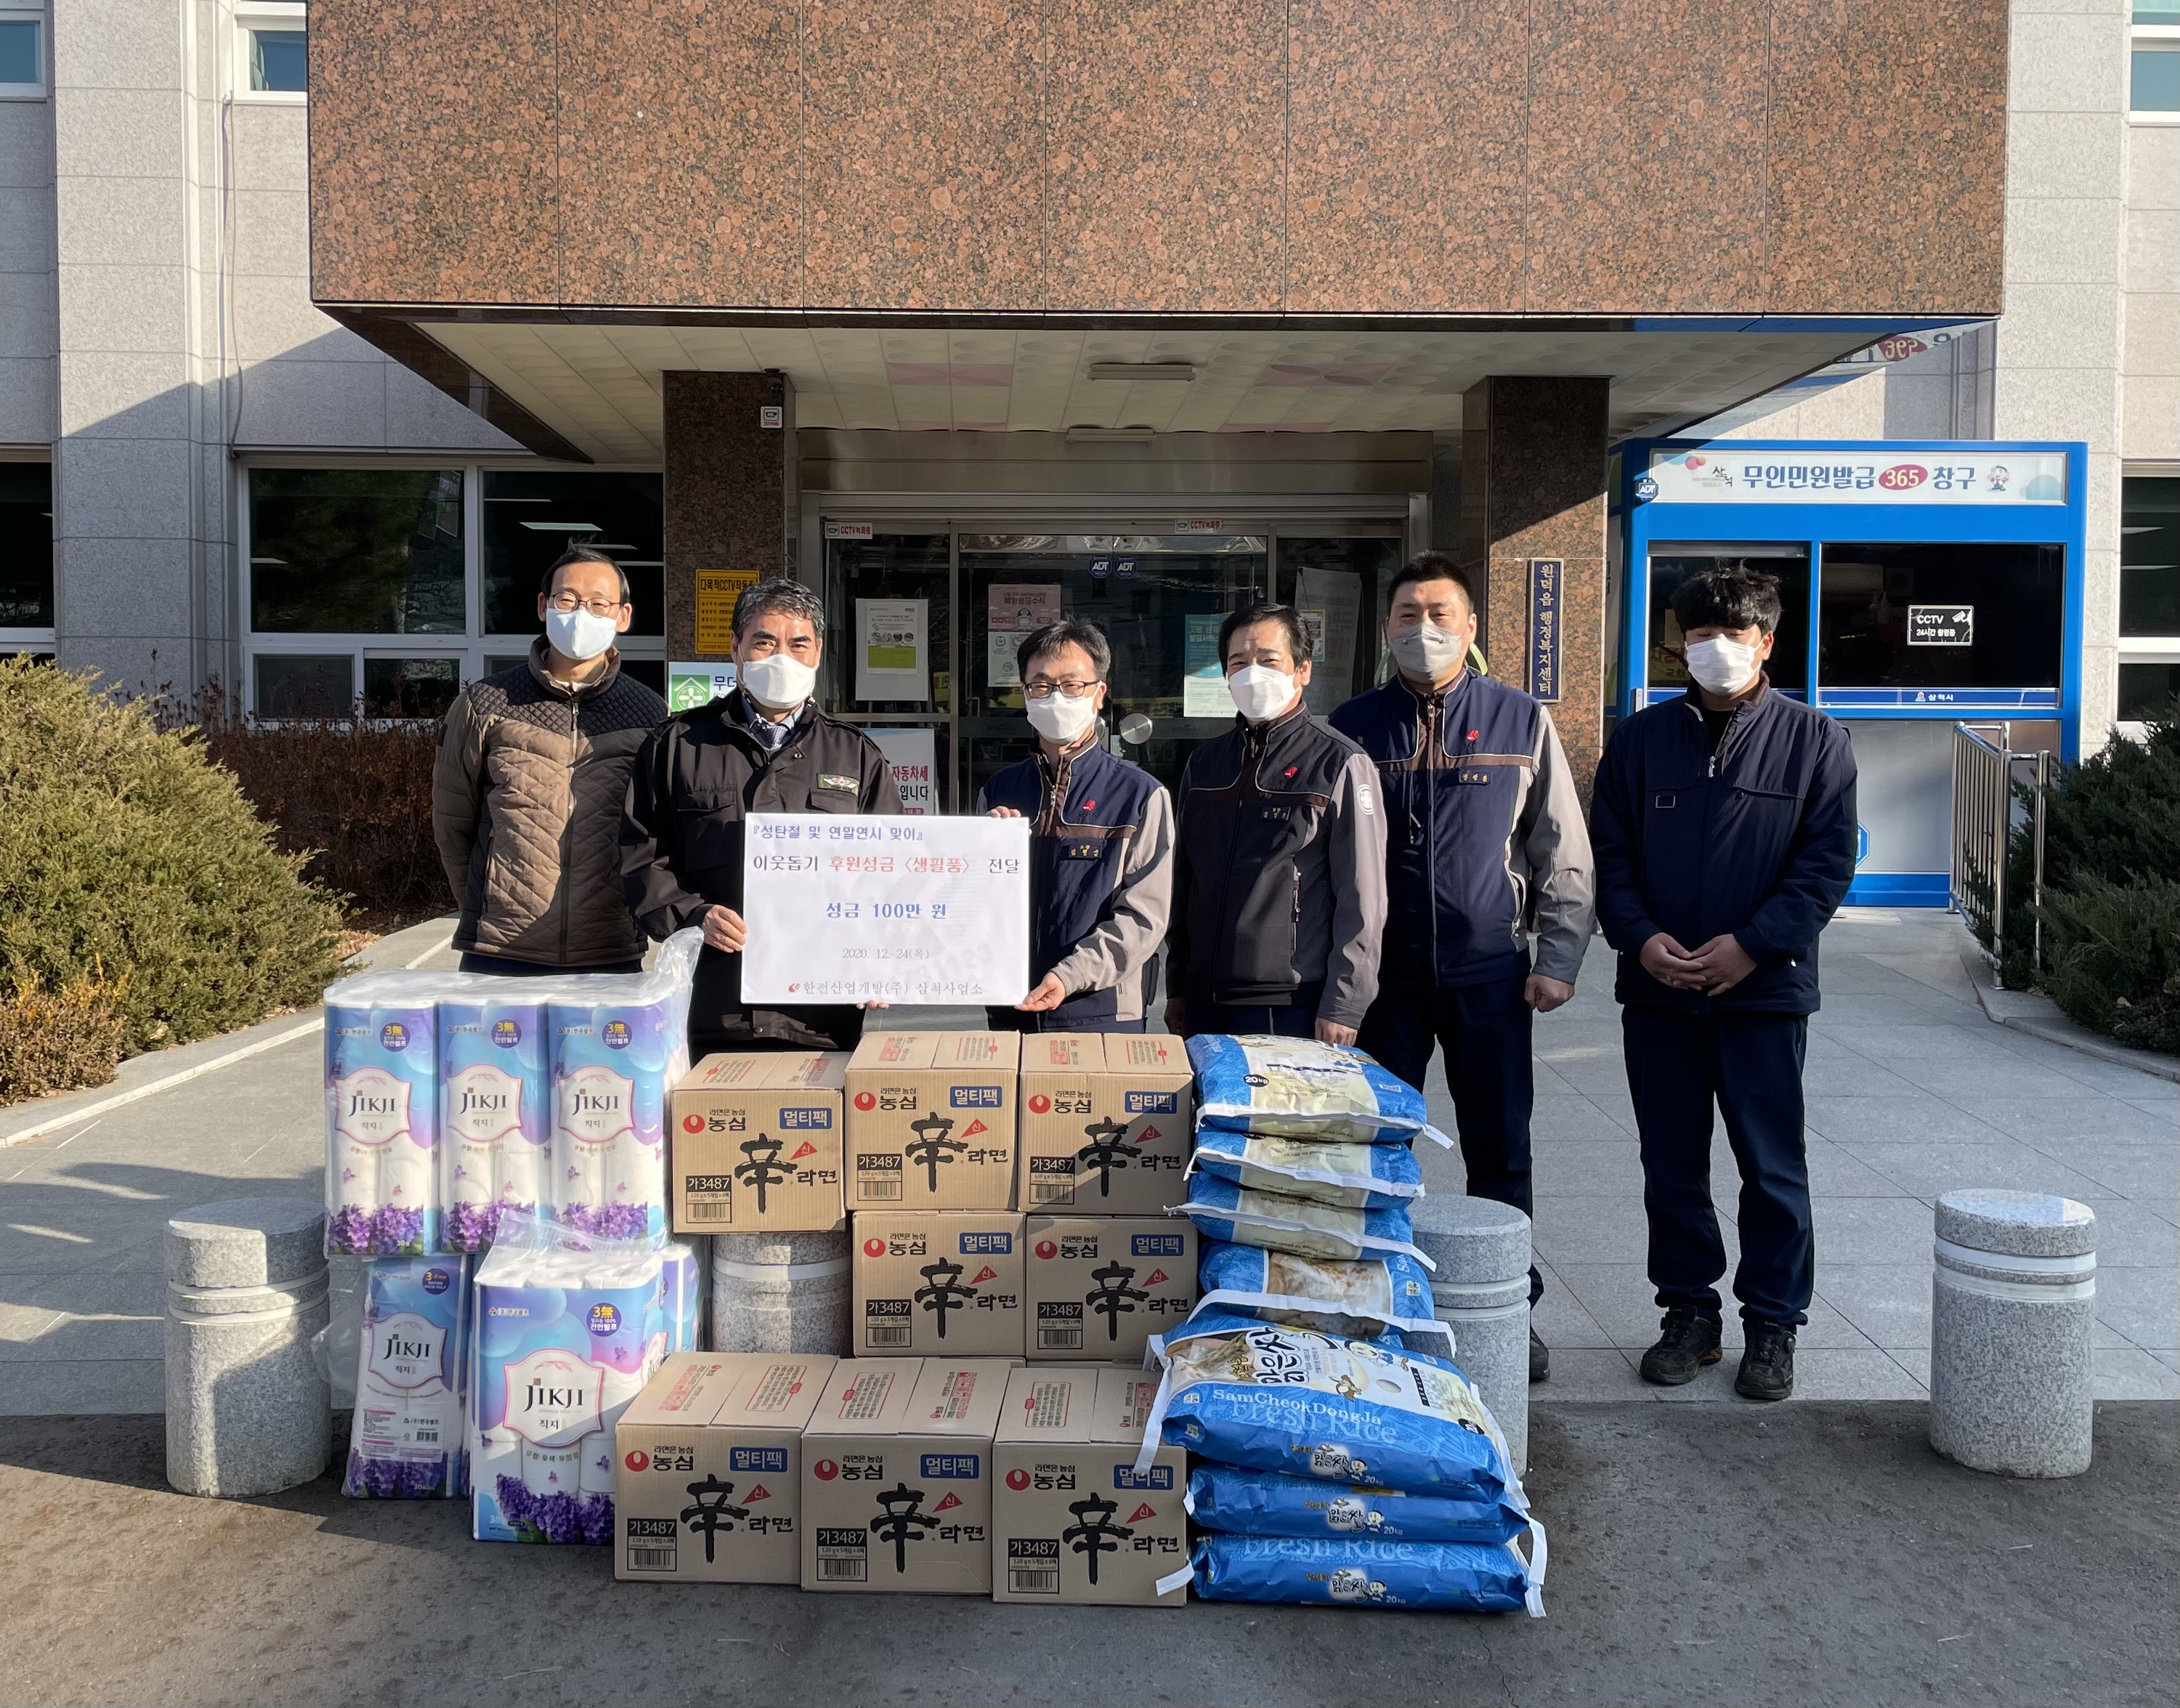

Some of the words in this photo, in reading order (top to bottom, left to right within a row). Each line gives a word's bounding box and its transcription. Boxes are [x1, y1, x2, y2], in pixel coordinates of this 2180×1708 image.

[1743, 466, 1876, 489] 무인민원발급
[1885, 469, 1920, 487] 365
[1932, 466, 1977, 490] 창구
[1092, 561, 1109, 572] ADT
[1117, 562, 1135, 572] ADT
[1539, 564, 1555, 607] 원덕읍
[1916, 615, 1944, 624] CCTV
[1538, 611, 1554, 695] 행정복지센터
[891, 765, 928, 782] 자동차세
[809, 825, 822, 840] 및
[829, 825, 882, 841] 연말연시
[753, 855, 819, 872] 이웃돕기
[829, 857, 895, 873] 후원성금
[987, 858, 1020, 874] 전달
[826, 902, 861, 919] 성금
[872, 903, 921, 918] 100만
[931, 903, 947, 920] 원
[843, 948, 870, 959] 2020.
[876, 949, 891, 959] 12.
[803, 982, 909, 995] 한전산업개발(주)
[916, 982, 984, 995] 삼척사업소
[1244, 1076, 1268, 1085] 20kg
[459, 1092, 507, 1114] JIKJI
[571, 1093, 619, 1116] JIKJI
[879, 1096, 917, 1111] 농심
[955, 1088, 998, 1105] 멀티팩
[1129, 1094, 1172, 1111] 멀티팩
[348, 1095, 396, 1117] JIKJI
[1053, 1098, 1092, 1114] 농심
[708, 1117, 746, 1132] 농심
[784, 1110, 828, 1127] 멀티팩
[972, 1122, 981, 1132] 신
[1146, 1128, 1156, 1138] 신
[801, 1145, 811, 1154] 신
[905, 1112, 969, 1193] 辛
[968, 1149, 1008, 1165] 라면
[1078, 1116, 1143, 1197] 辛
[859, 1156, 901, 1169] 가3487
[1032, 1159, 1074, 1172] 가3487
[1140, 1154, 1182, 1171] 라면
[734, 1133, 798, 1214] 辛
[797, 1169, 838, 1186] 라면
[688, 1177, 730, 1191] 가3487
[888, 1241, 927, 1256] 농심
[963, 1235, 1008, 1252] 멀티팩
[1060, 1243, 1098, 1259] 농심
[1135, 1237, 1180, 1255] 멀티팩
[981, 1269, 991, 1279] 신
[1153, 1272, 1163, 1282] 신
[915, 1257, 978, 1339] 辛
[976, 1294, 1018, 1311] 라면
[1086, 1260, 1150, 1342] 辛
[1148, 1297, 1190, 1314] 라면
[868, 1301, 910, 1314] 가3487
[1040, 1304, 1082, 1317] 가3487
[383, 1338, 431, 1360] JIKJI
[395, 1365, 410, 1374] 직지
[523, 1384, 584, 1412] JIKJI
[1212, 1388, 1382, 1425] SamCheokDongJa
[539, 1419, 559, 1430] 직지
[652, 1454, 694, 1472] 농심
[734, 1450, 784, 1470] 멀티팩
[925, 1457, 975, 1476] 멀티팩
[1059, 1464, 1076, 1473] 농심
[841, 1464, 883, 1481] 농심
[1363, 1475, 1384, 1486] 20kg
[1033, 1473, 1076, 1490] 농심
[754, 1488, 764, 1499] 신
[946, 1496, 955, 1507] 신
[680, 1473, 750, 1563] 辛
[1139, 1507, 1149, 1517] 신
[629, 1521, 676, 1535] 가3487
[748, 1515, 793, 1535] 라면
[870, 1482, 941, 1574] 辛
[939, 1524, 985, 1543] 라면
[1383, 1526, 1403, 1536] 20kg
[819, 1530, 866, 1545] 가3487
[1062, 1492, 1135, 1585] 辛
[1133, 1535, 1180, 1555] 라면
[1010, 1540, 1058, 1555] 가3487
